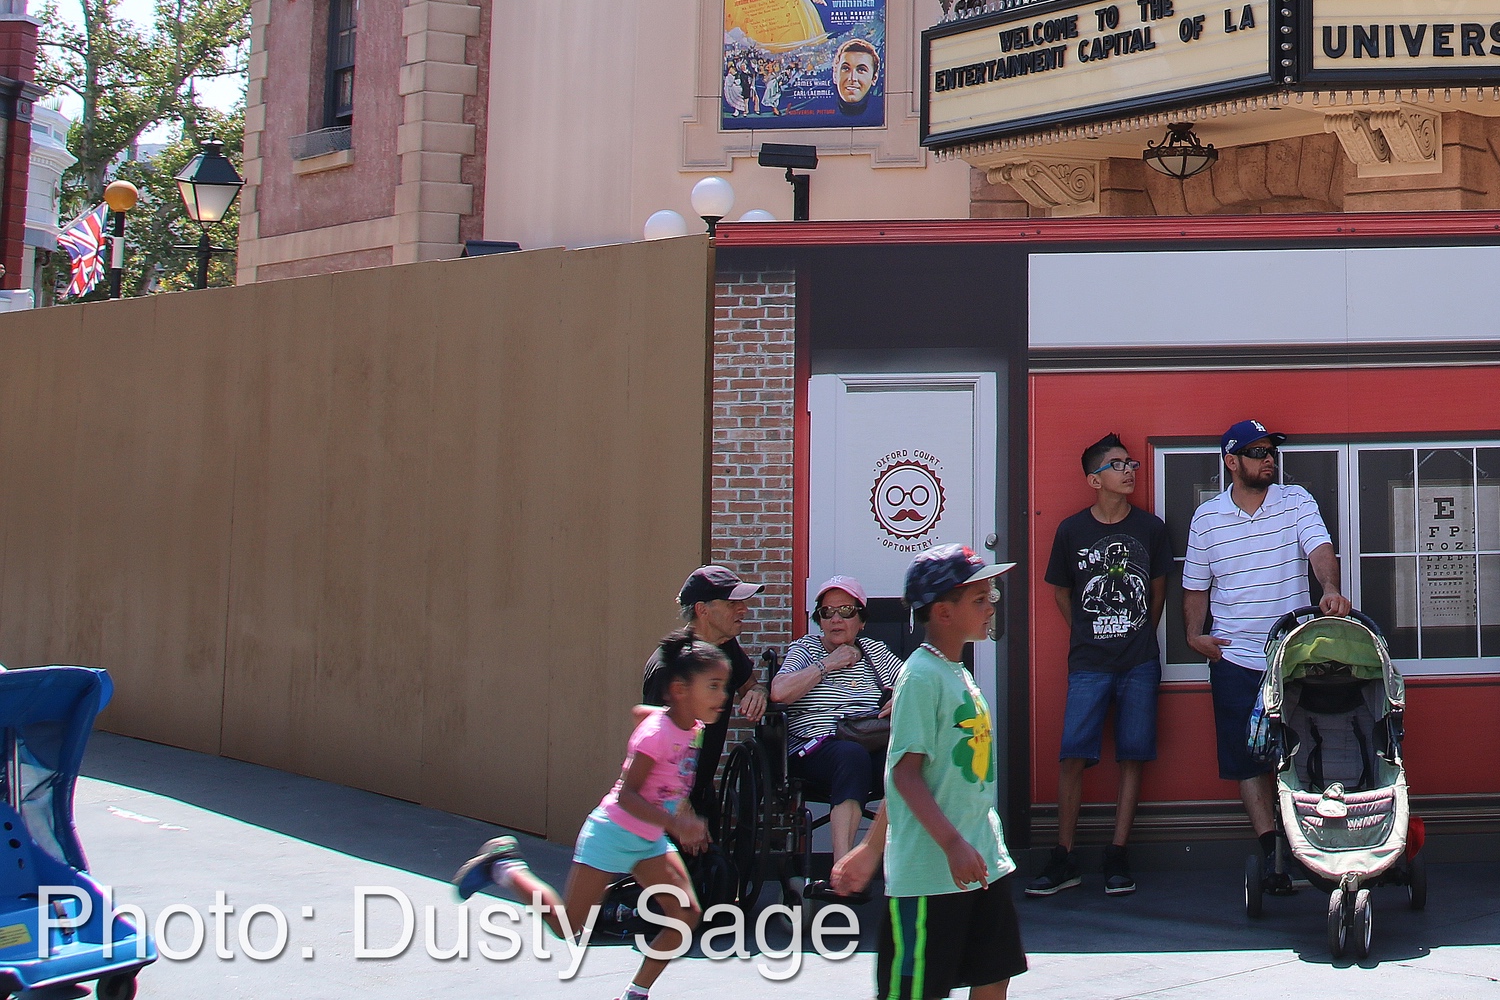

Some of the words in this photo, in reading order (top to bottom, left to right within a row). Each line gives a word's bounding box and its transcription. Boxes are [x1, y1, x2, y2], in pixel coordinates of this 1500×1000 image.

[999, 14, 1079, 53] WELCOME
[1095, 7, 1120, 32] TO
[935, 45, 1067, 93] ENTERTAINMENT
[1077, 26, 1156, 63] CAPITAL
[1179, 14, 1205, 43] OF
[1224, 4, 1255, 33] LA
[876, 449, 908, 468] OXFORD
[913, 449, 941, 466] COURT
[1433, 497, 1454, 519] E
[882, 538, 933, 553] OPTOMETRY
[1092, 615, 1131, 626] STAR
[1092, 624, 1131, 635] WARS
